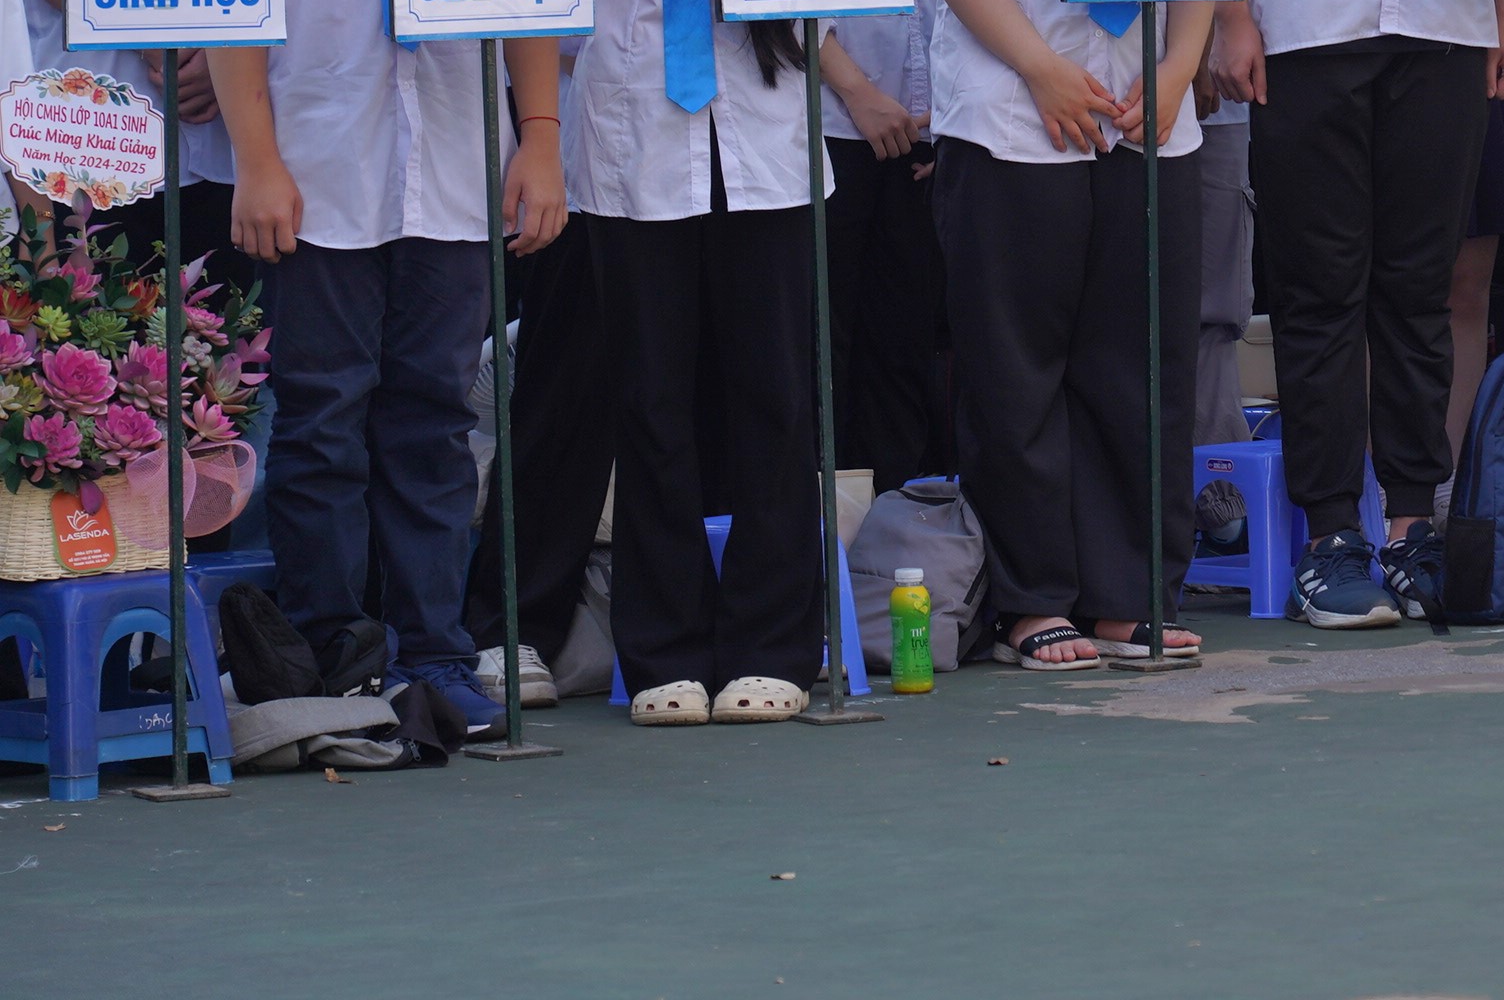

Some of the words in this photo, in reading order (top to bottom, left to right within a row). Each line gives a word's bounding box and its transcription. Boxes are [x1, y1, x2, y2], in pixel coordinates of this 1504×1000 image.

[14, 98, 33, 120] HỘI
[36, 103, 67, 123] CMHS
[70, 105, 91, 126] LỚP
[94, 111, 118, 130] 10A1
[121, 114, 148, 134] SINH
[9, 123, 42, 141] Chúc
[45, 127, 83, 150] Mừng
[86, 133, 116, 151] Khai
[119, 138, 157, 159] Giảng
[22, 147, 51, 162] Năm
[54, 151, 76, 166] Học
[79, 155, 146, 175] 2024-2025
[59, 528, 110, 543] LASENDA
[1034, 629, 1081, 643] Fashion
